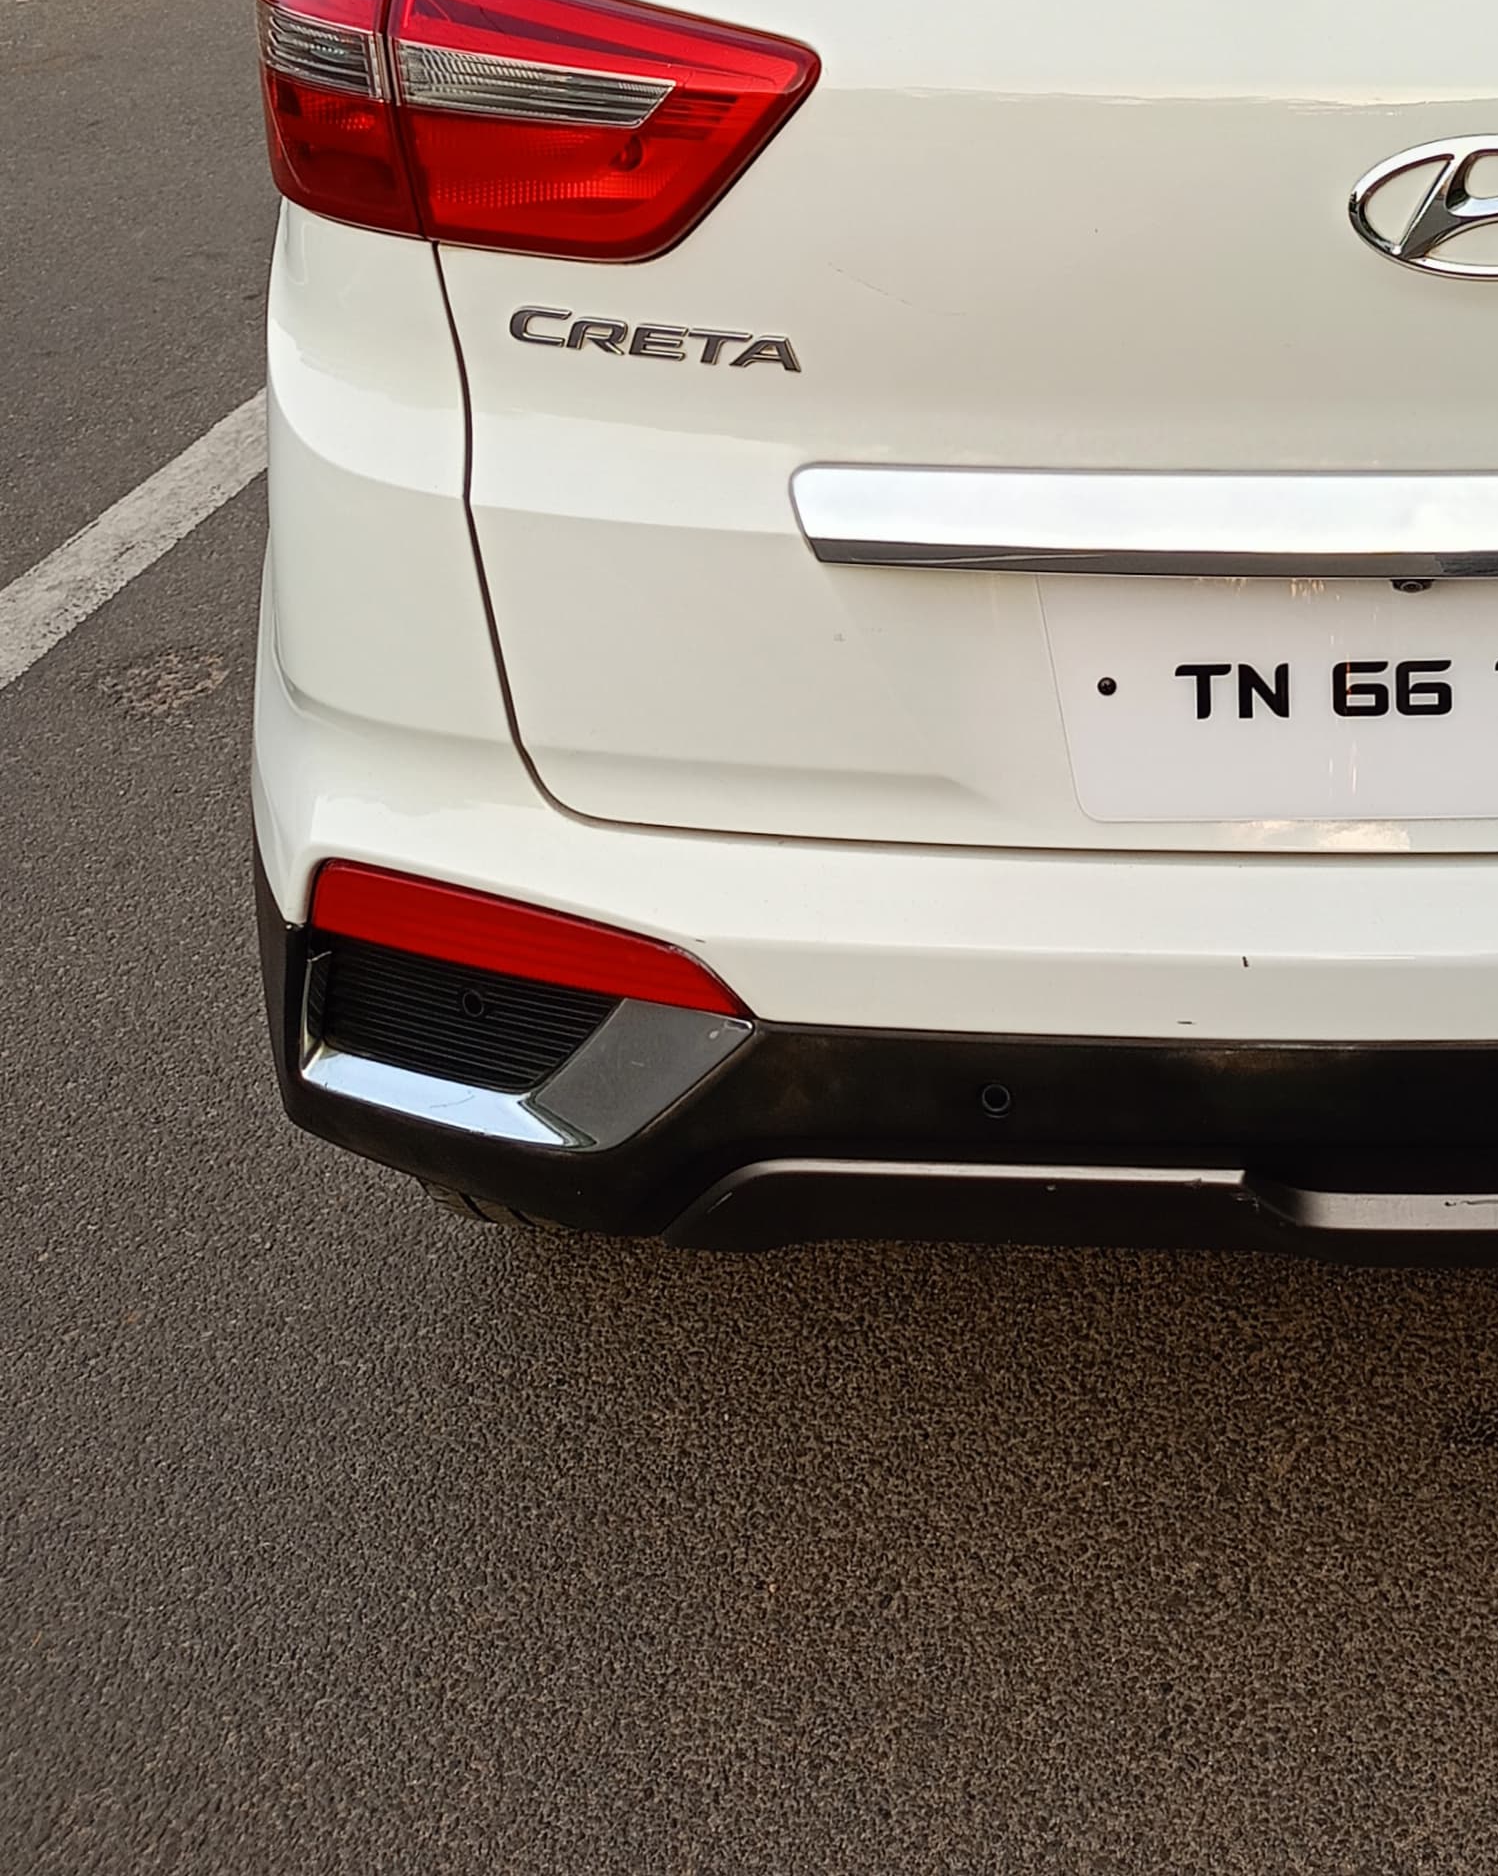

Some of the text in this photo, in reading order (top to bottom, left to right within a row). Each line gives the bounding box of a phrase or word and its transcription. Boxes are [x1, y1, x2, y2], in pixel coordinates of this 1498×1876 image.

[509, 305, 801, 373] CRETA
[1175, 663, 1289, 719] TN
[1333, 660, 1452, 716] 66
